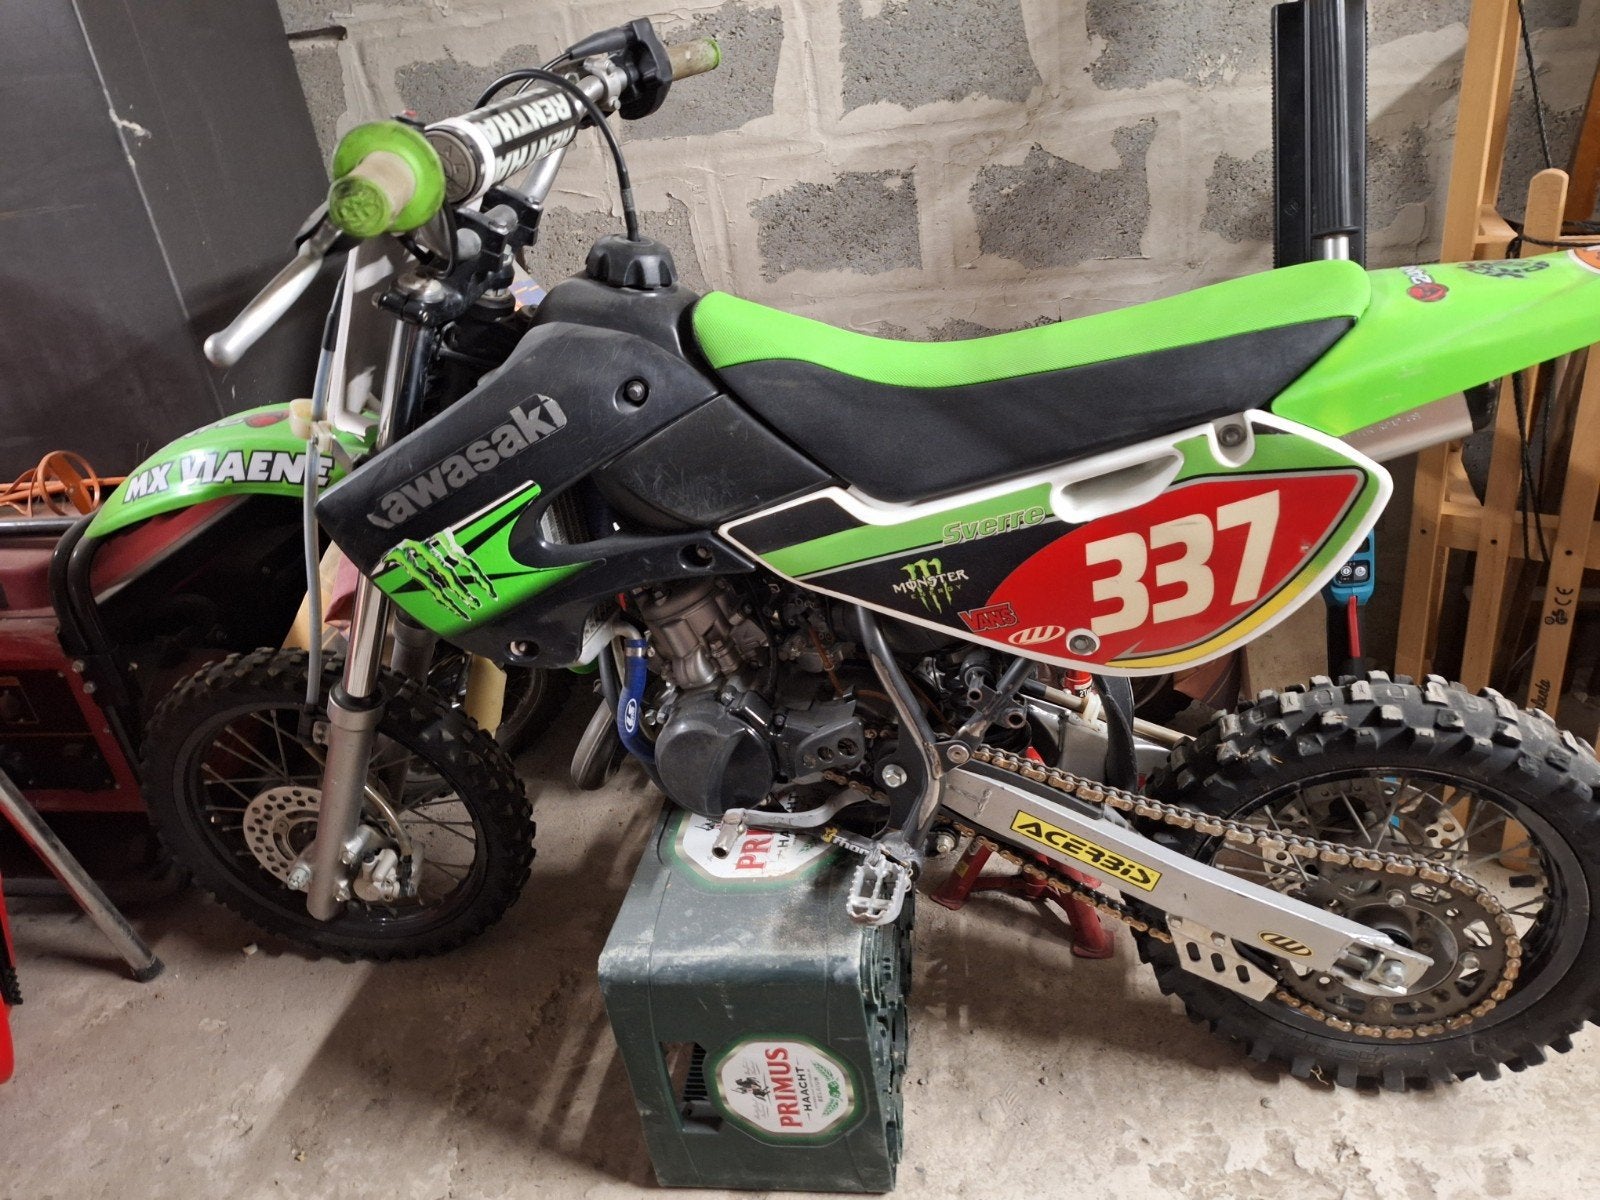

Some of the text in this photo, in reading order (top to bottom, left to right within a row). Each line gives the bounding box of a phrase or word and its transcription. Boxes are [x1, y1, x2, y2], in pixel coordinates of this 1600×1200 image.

[123, 450, 336, 504] MX VIAENE
[366, 393, 568, 530] awasaki
[942, 505, 1047, 546] Sverre
[892, 569, 970, 594] MONSTER
[1085, 489, 1280, 637] 337
[957, 602, 1019, 633] VANS
[1017, 821, 1152, 885] ACERBIS
[765, 1047, 803, 1128] PRIMUS
[795, 1067, 813, 1112] HAACHT
